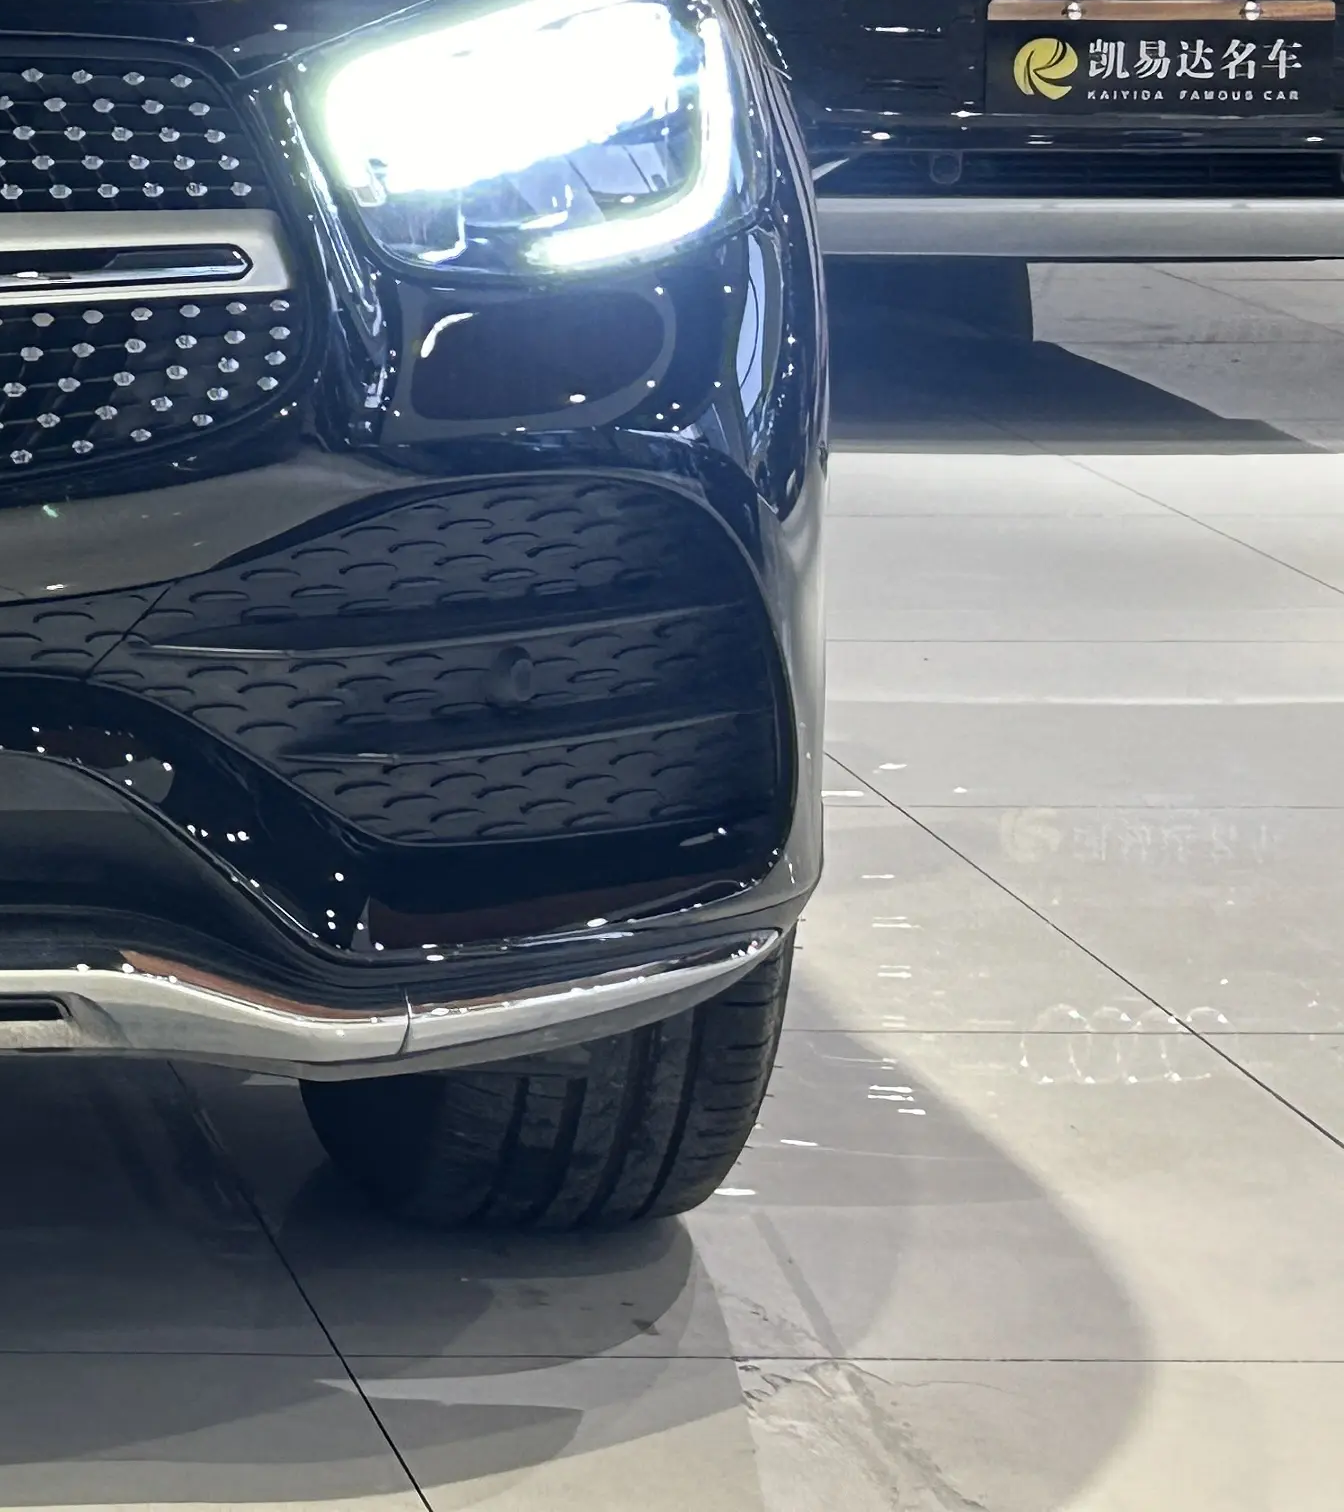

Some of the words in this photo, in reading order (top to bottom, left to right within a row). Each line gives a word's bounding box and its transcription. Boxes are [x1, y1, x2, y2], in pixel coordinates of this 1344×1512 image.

[1088, 38, 1303, 80] 凯易达名车
[1087, 89, 1164, 101] KAIYIDA
[1179, 89, 1254, 101] FAMOUS
[1263, 89, 1300, 101] CAR
